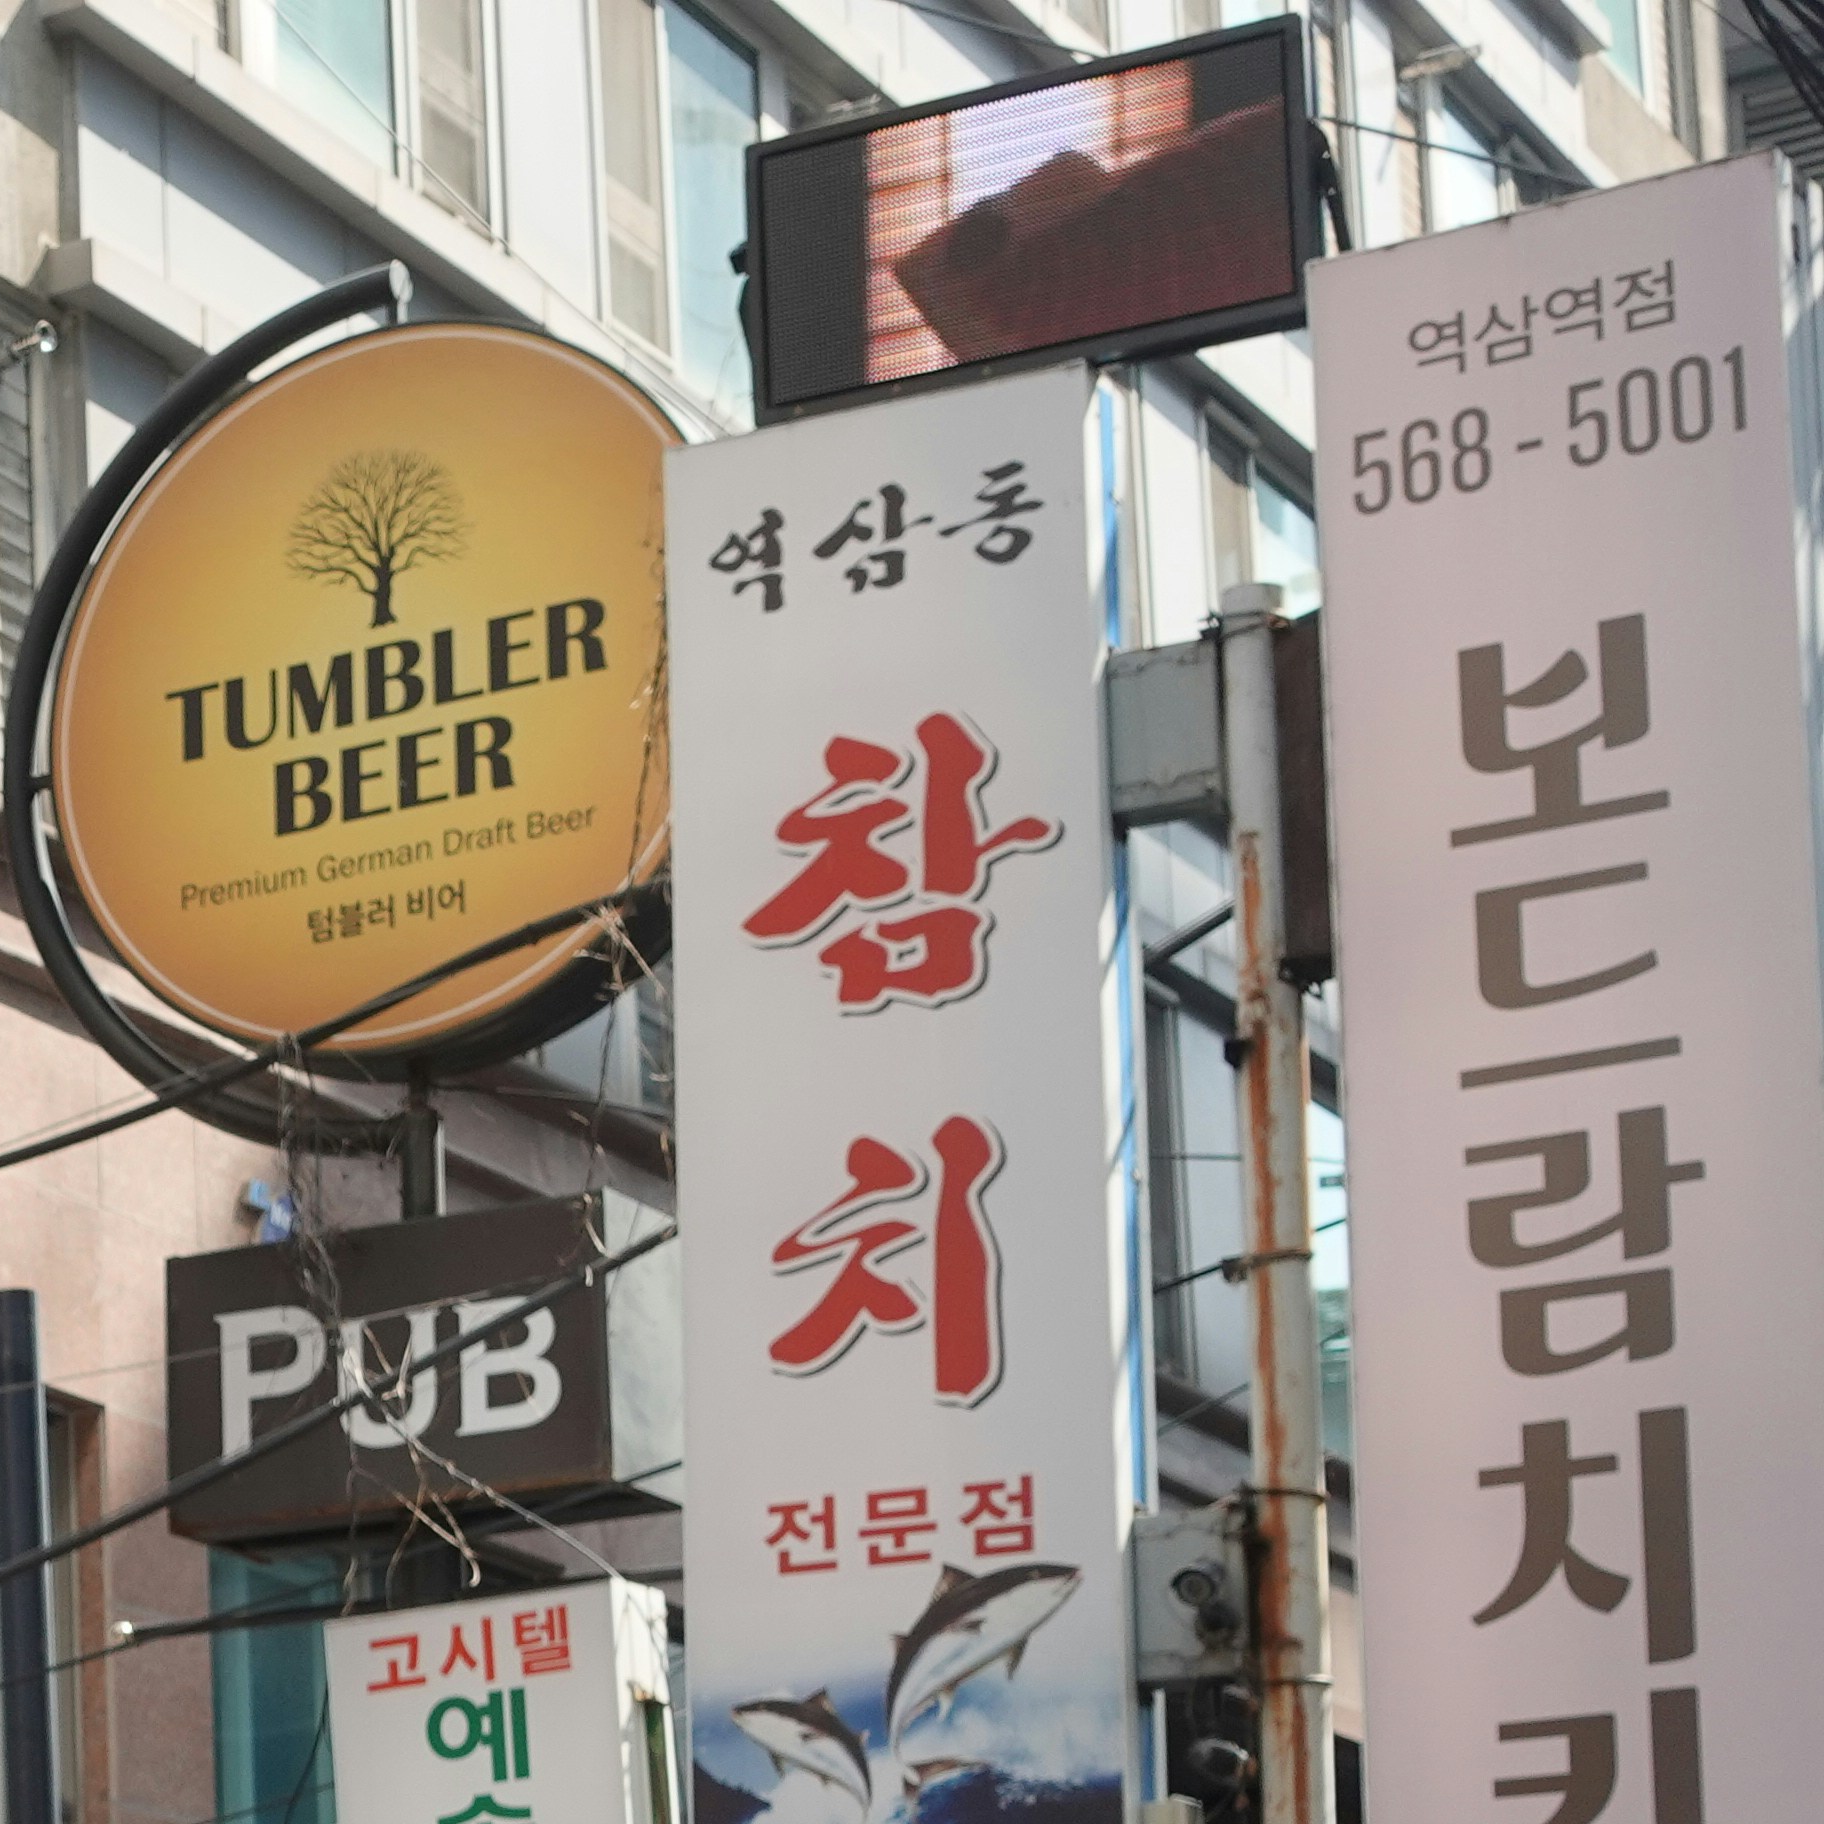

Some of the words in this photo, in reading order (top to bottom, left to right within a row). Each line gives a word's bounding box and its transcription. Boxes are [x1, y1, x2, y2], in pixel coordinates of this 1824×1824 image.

[1406, 259, 1677, 375] 역삼역점
[708, 459, 1046, 614] 역삼동
[165, 597, 609, 763] TUMBLER
[272, 714, 516, 838] BEER
[179, 863, 307, 912] Premium
[316, 836, 434, 886] German
[442, 819, 518, 857] Draft
[526, 805, 597, 843] Beer
[306, 893, 397, 945] 텀블러
[406, 879, 468, 924] 비어
[742, 710, 1065, 1411] 참치
[213, 1295, 563, 1467] PUB
[764, 1473, 1037, 1577] 전문점
[365, 1604, 574, 1694] 고시텔
